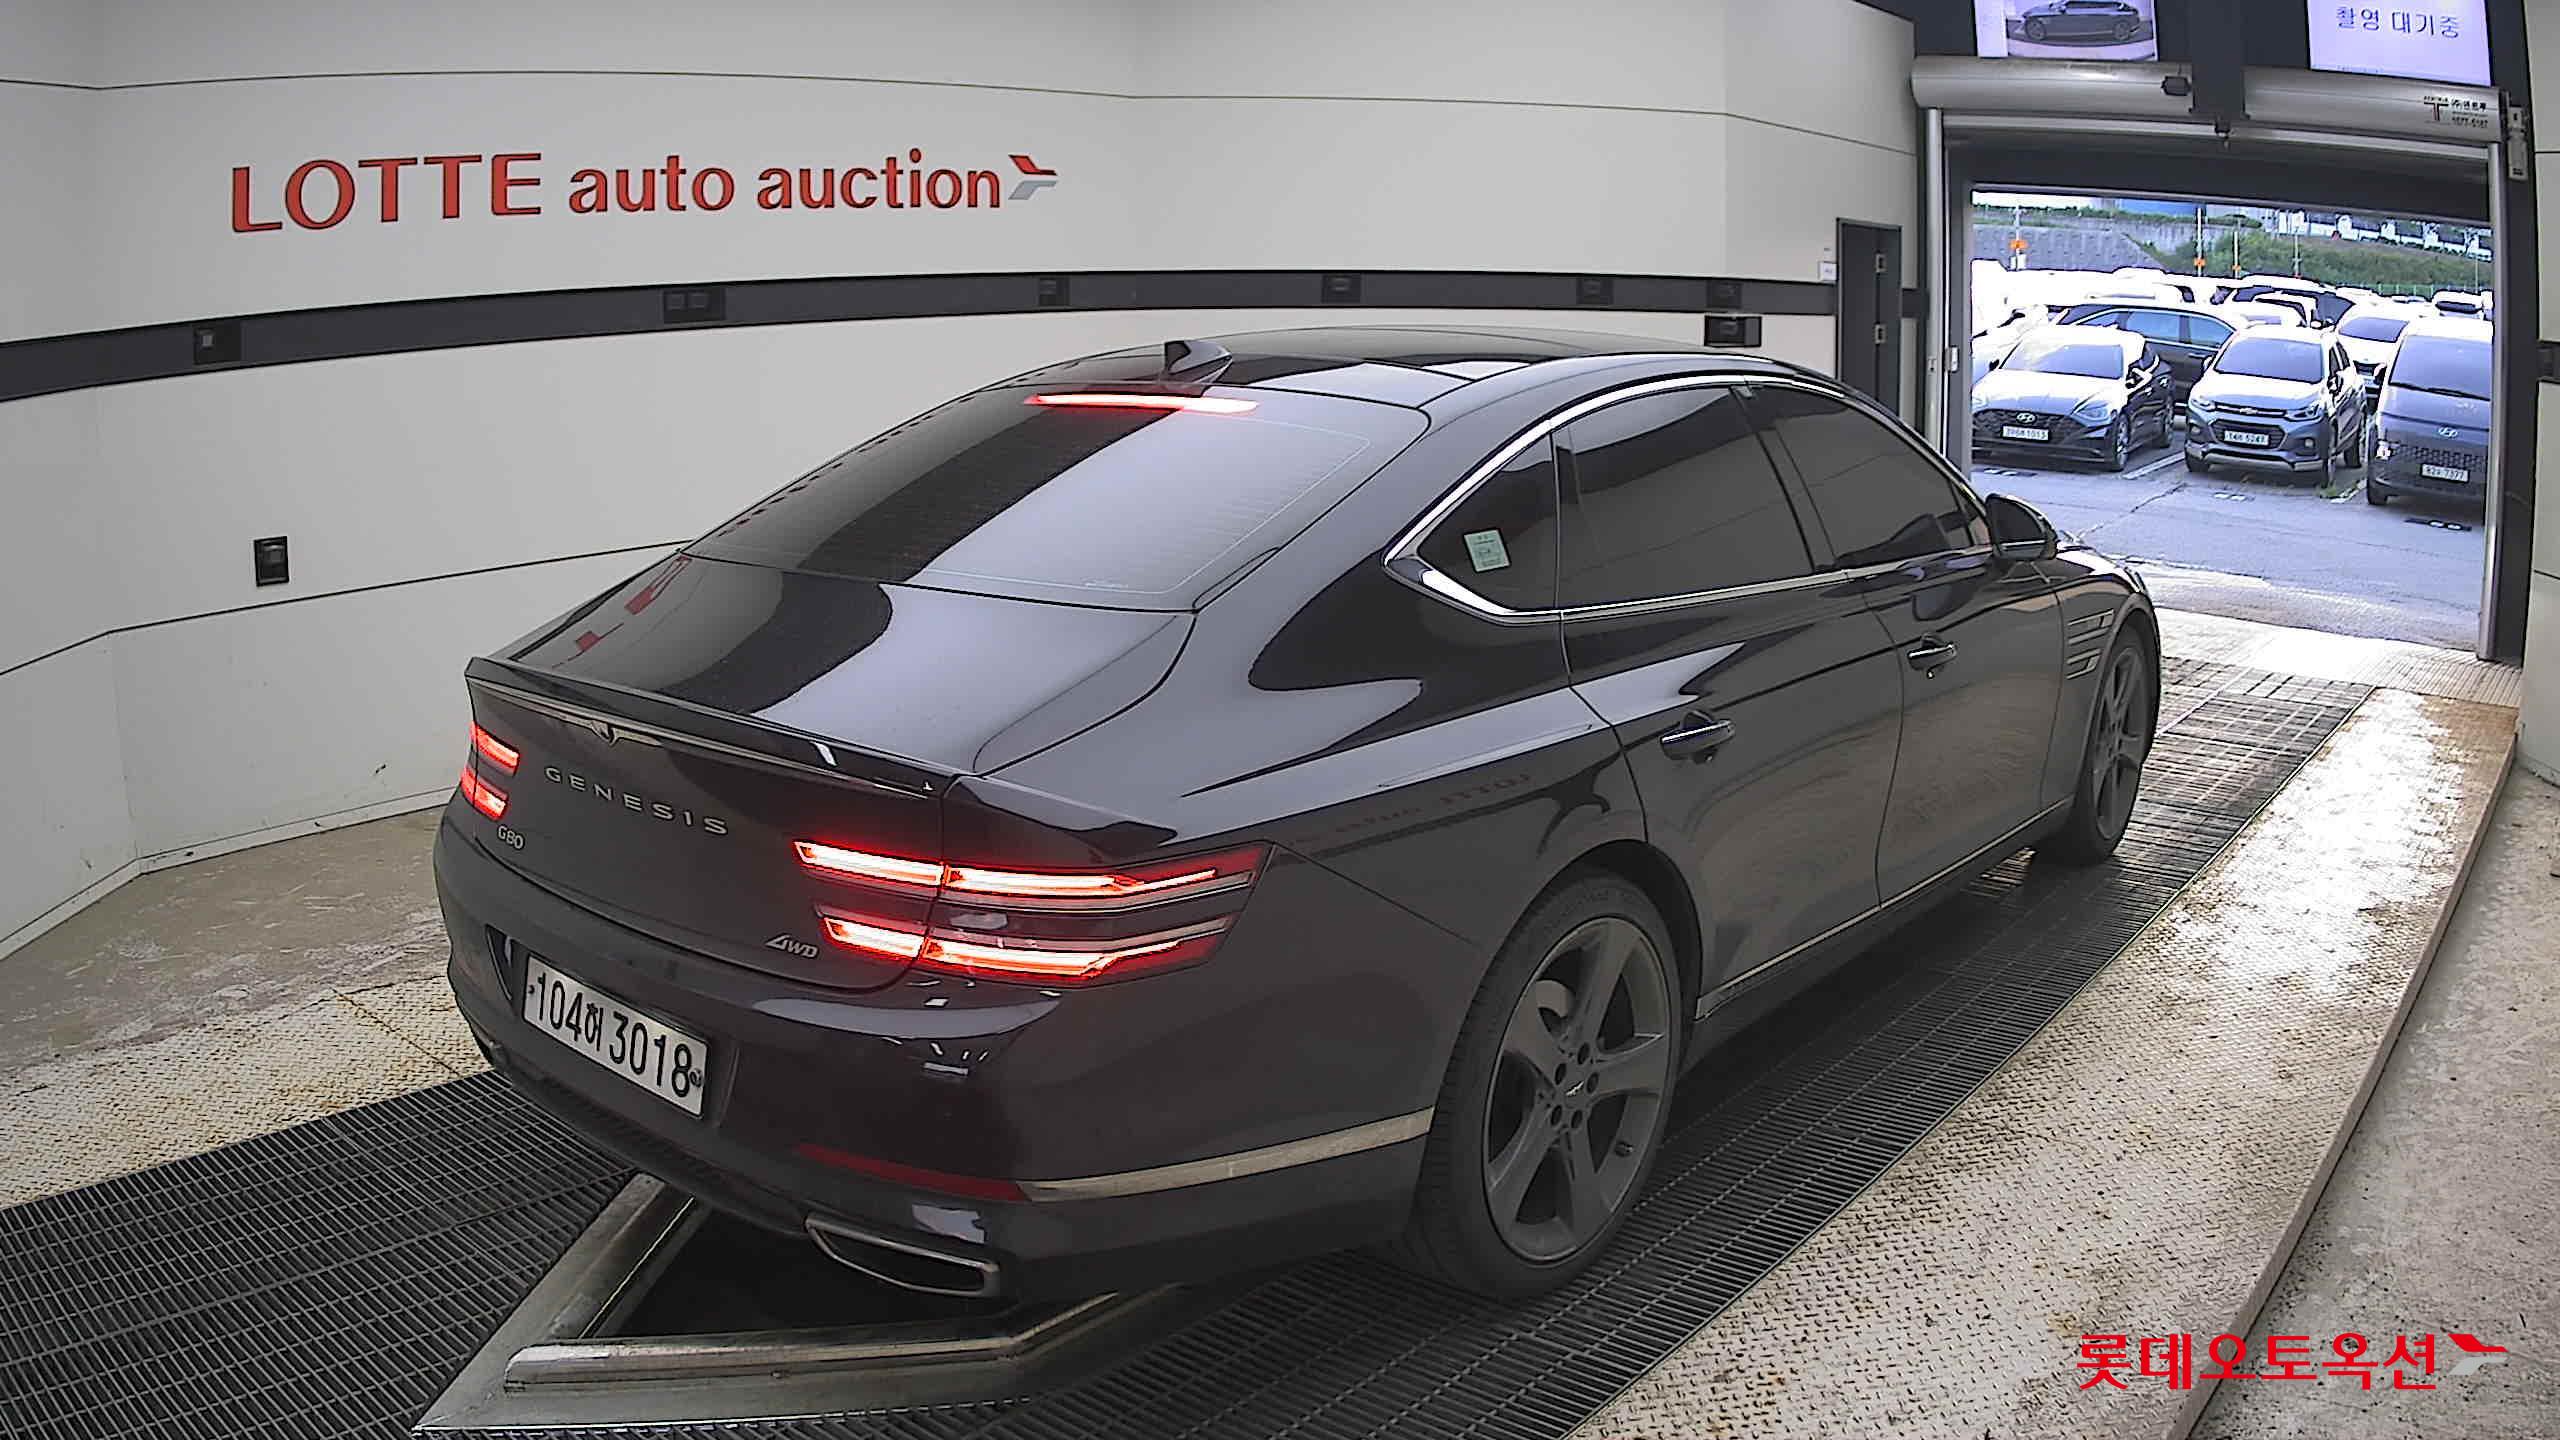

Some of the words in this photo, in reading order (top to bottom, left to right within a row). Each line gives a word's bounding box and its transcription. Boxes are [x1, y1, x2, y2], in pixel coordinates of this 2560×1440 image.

[2336, 6, 2379, 31] 촬영
[2391, 8, 2460, 38] 대기중
[232, 151, 542, 232] LOTTE
[568, 154, 735, 213] auto
[756, 147, 1001, 209] auction
[545, 767, 728, 835] GENESIS
[497, 825, 525, 850] G80
[765, 933, 819, 961] AWD
[537, 972, 604, 1052] 104허
[609, 1010, 692, 1098] 3018
